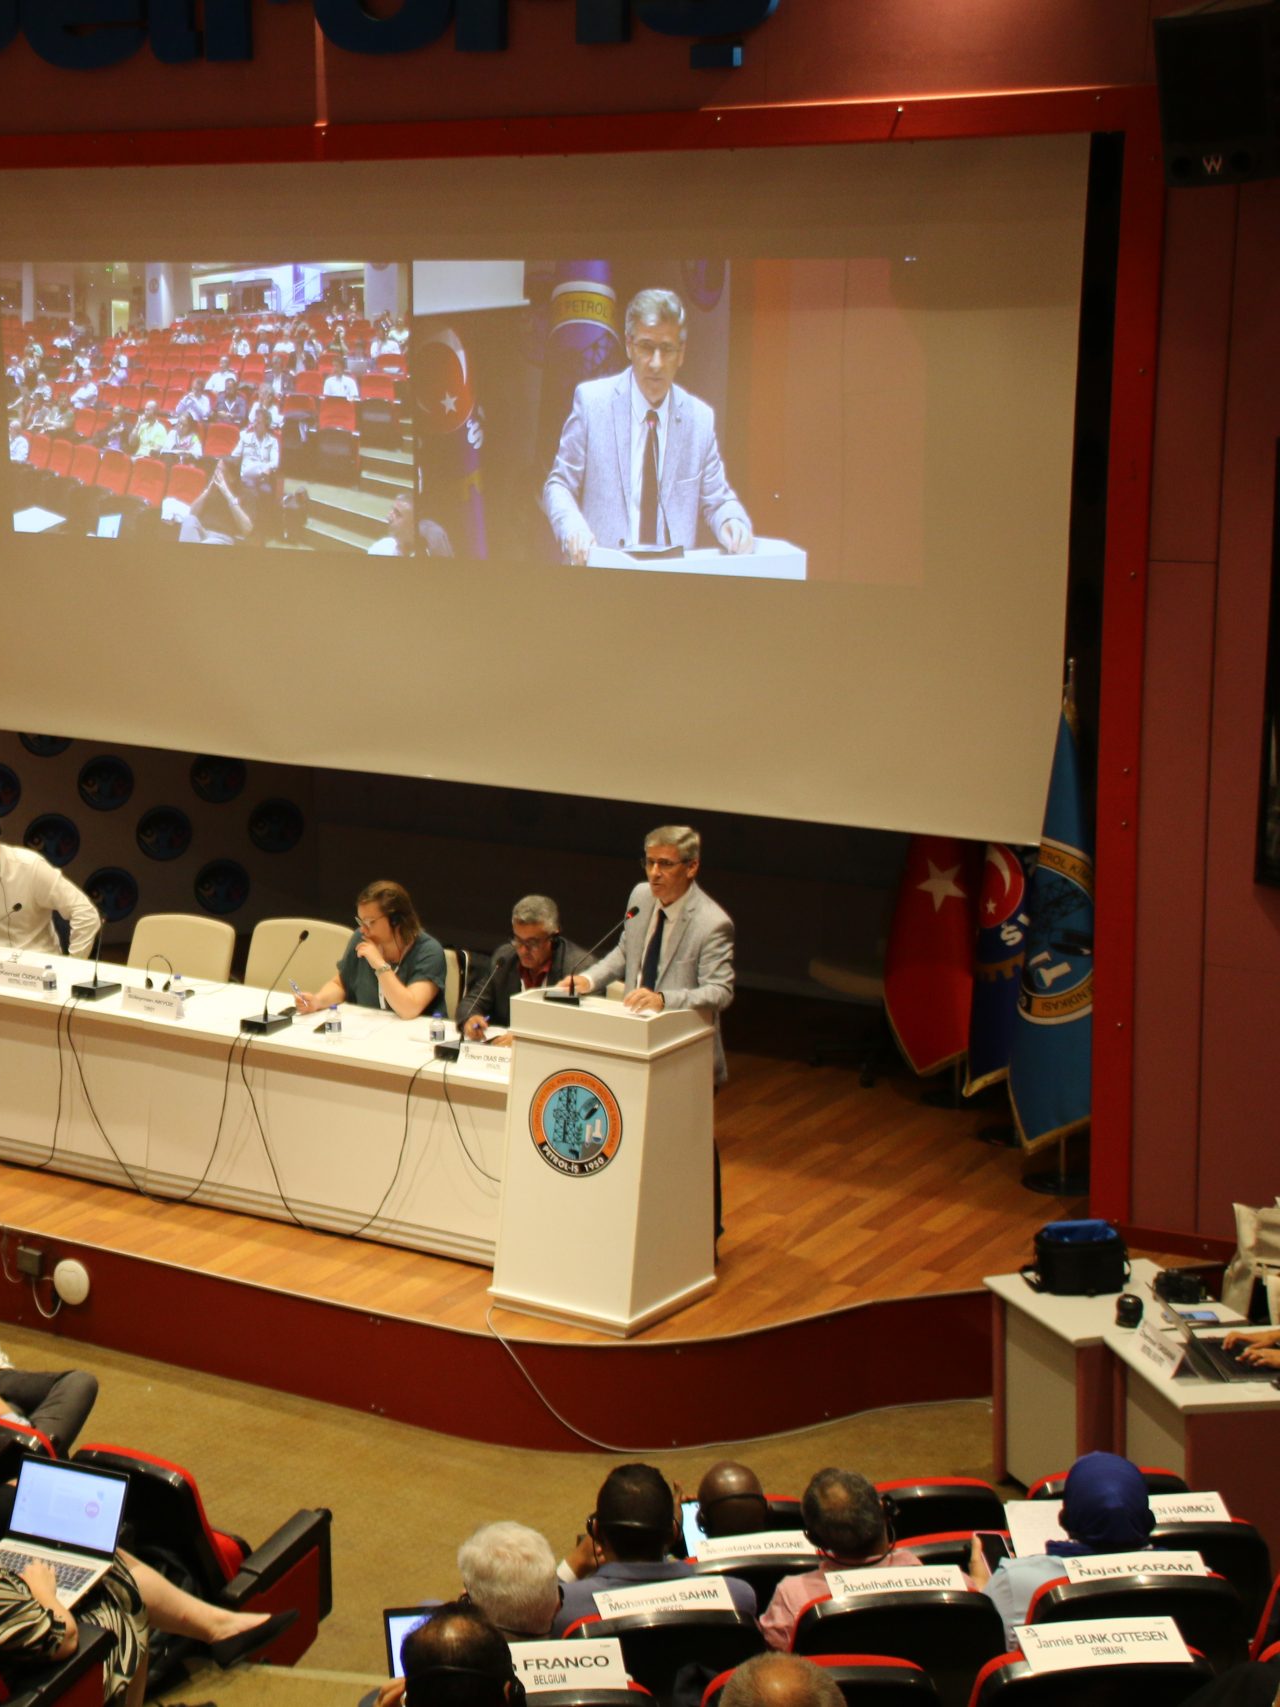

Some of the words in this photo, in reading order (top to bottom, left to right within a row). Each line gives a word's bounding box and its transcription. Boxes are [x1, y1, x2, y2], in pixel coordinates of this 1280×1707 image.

[22, 970, 43, 981] ÖZKA
[584, 1156, 605, 1172] 1950
[763, 1540, 805, 1551] DIAGNE
[1078, 1564, 1122, 1578] Najat
[1126, 1562, 1194, 1572] KARAM
[904, 1576, 953, 1589] ELHANY
[607, 1593, 678, 1612] Mohammed
[677, 1588, 720, 1603] SAHIM
[1036, 1635, 1074, 1650] Jannie
[1074, 1633, 1112, 1646] BUNK
[1111, 1631, 1169, 1644] OTTESEN
[1091, 1646, 1127, 1657] DENMARK
[522, 1655, 610, 1672] FRANCO
[533, 1673, 568, 1686] BELGIUM
